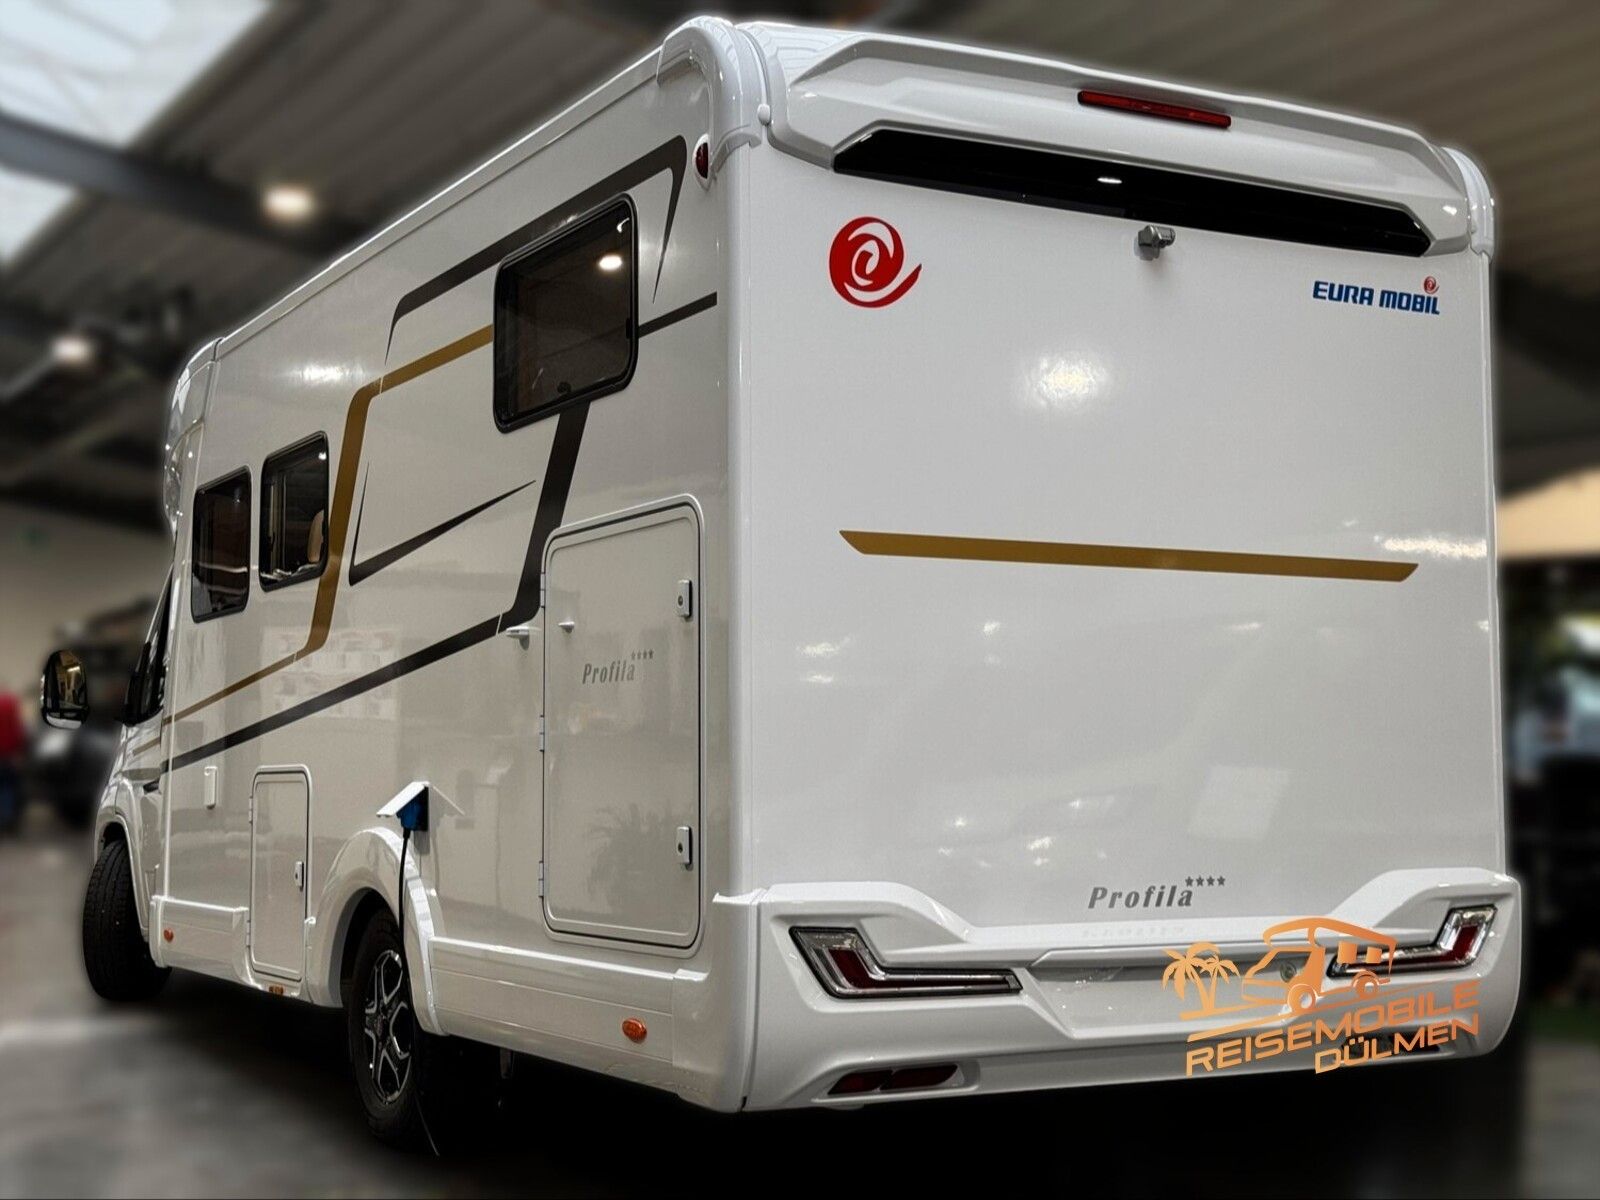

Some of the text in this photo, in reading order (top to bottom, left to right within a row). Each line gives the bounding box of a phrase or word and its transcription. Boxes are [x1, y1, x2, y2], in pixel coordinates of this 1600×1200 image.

[1312, 280, 1440, 315] EURA MOBIL
[582, 660, 635, 684] Profila
[1088, 885, 1193, 909] Profila
